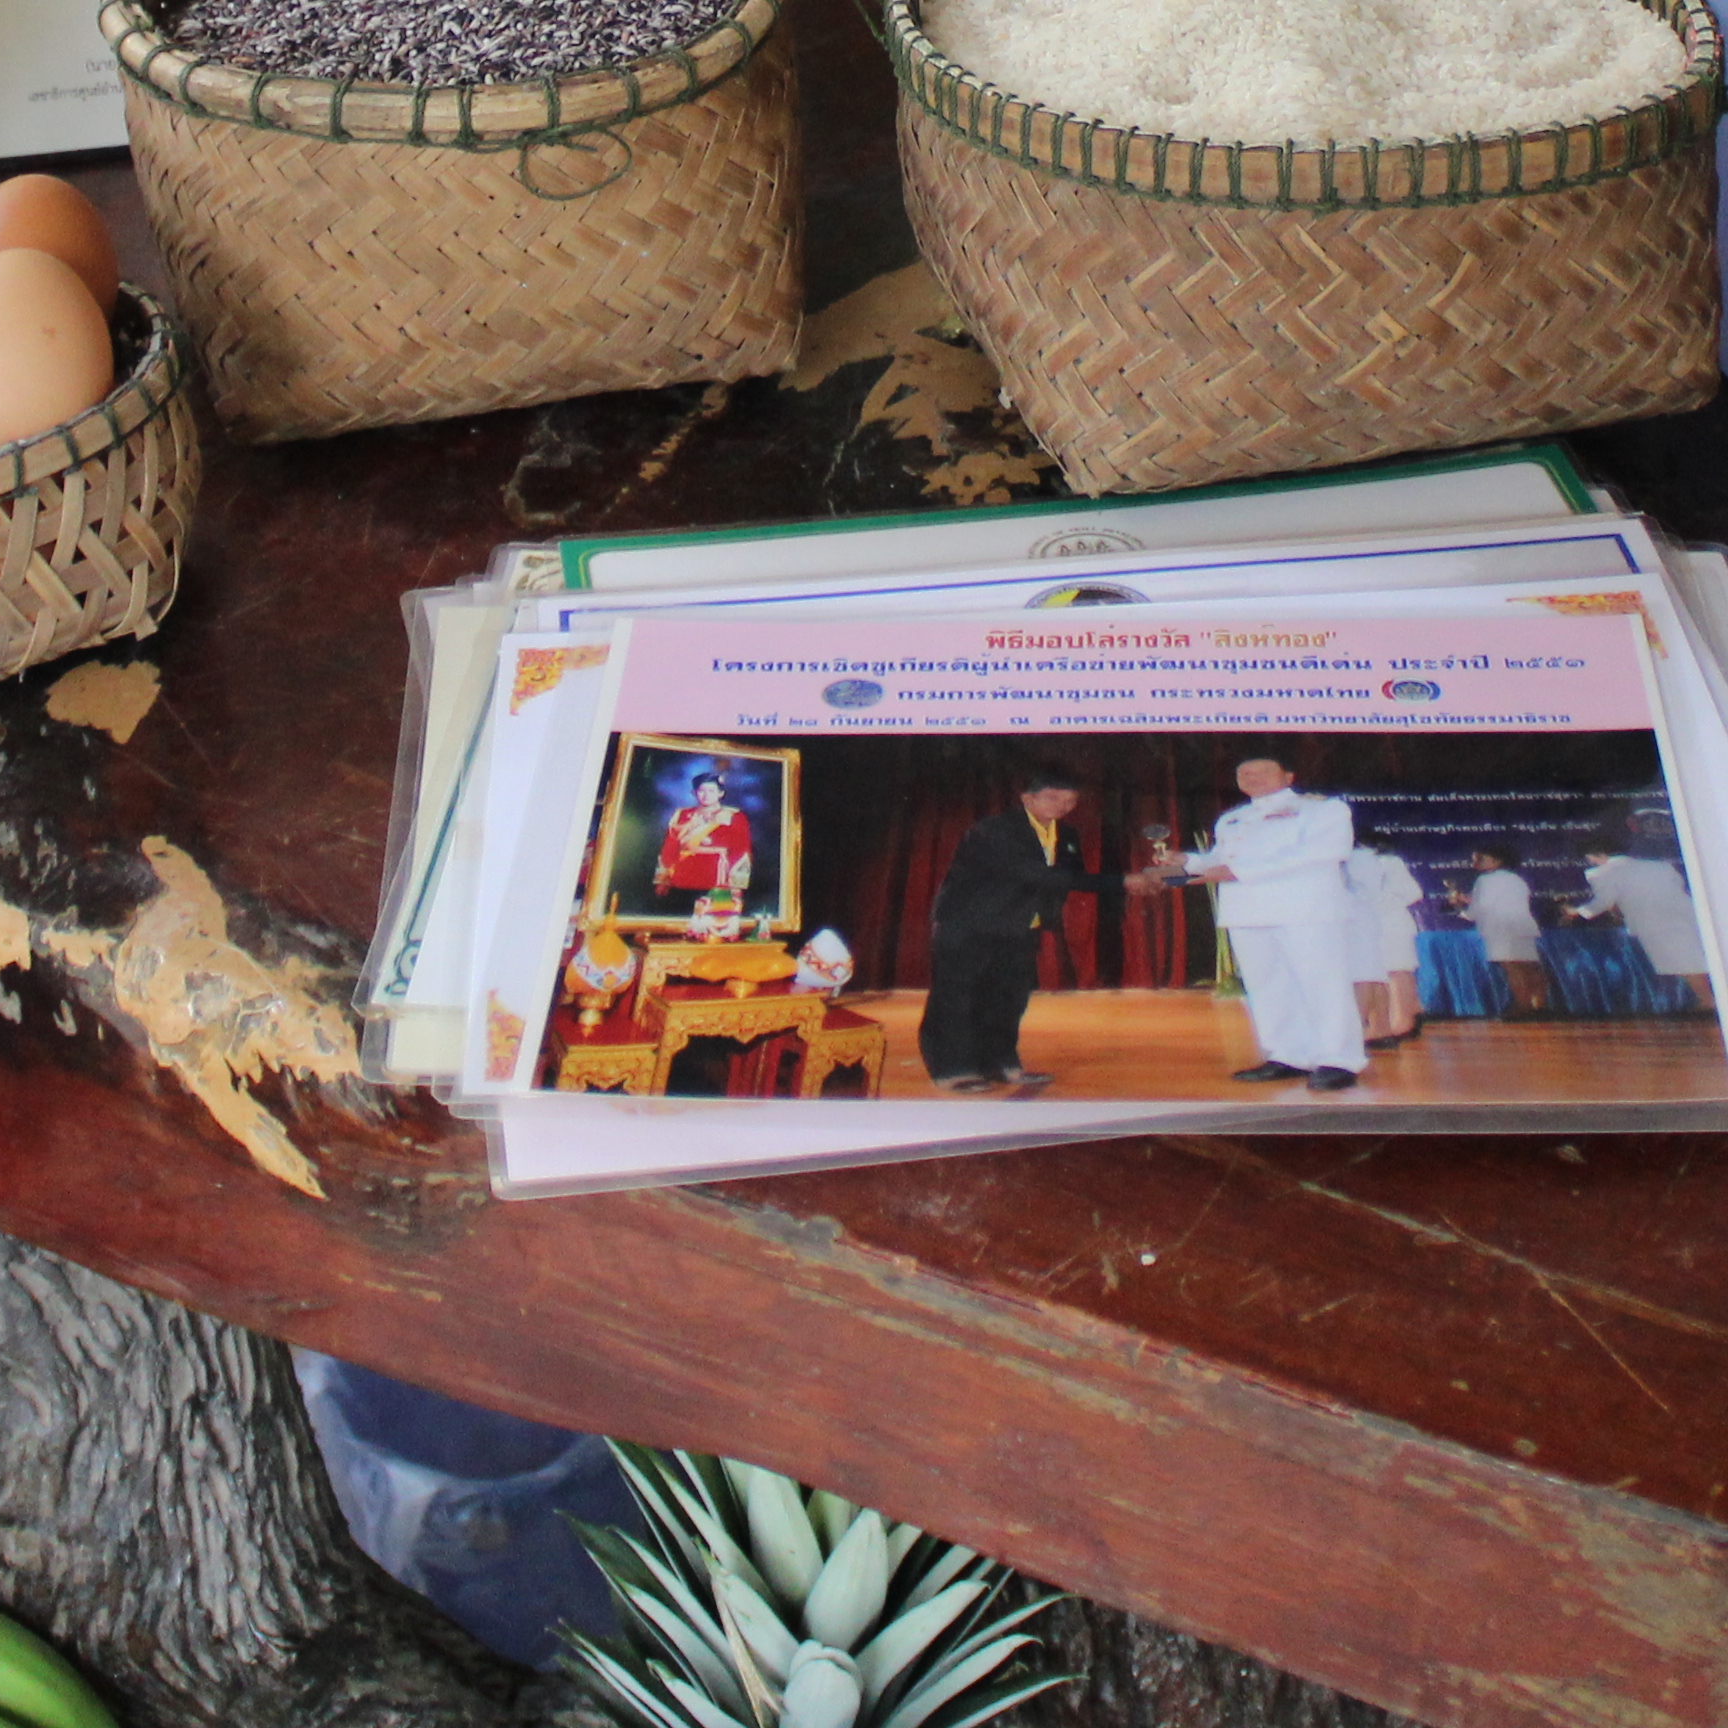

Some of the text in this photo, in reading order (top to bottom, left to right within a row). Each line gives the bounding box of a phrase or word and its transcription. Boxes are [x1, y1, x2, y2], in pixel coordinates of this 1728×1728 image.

[986, 623, 1191, 649] พิธีมอบโล่รางวัล
[1389, 654, 1490, 671] ประจำปี
[898, 686, 1370, 703] กรมการพัฒนาชุมชน กระทรวงมหาดไทย
[738, 712, 778, 727] วันที่
[830, 713, 913, 727] กันยายน
